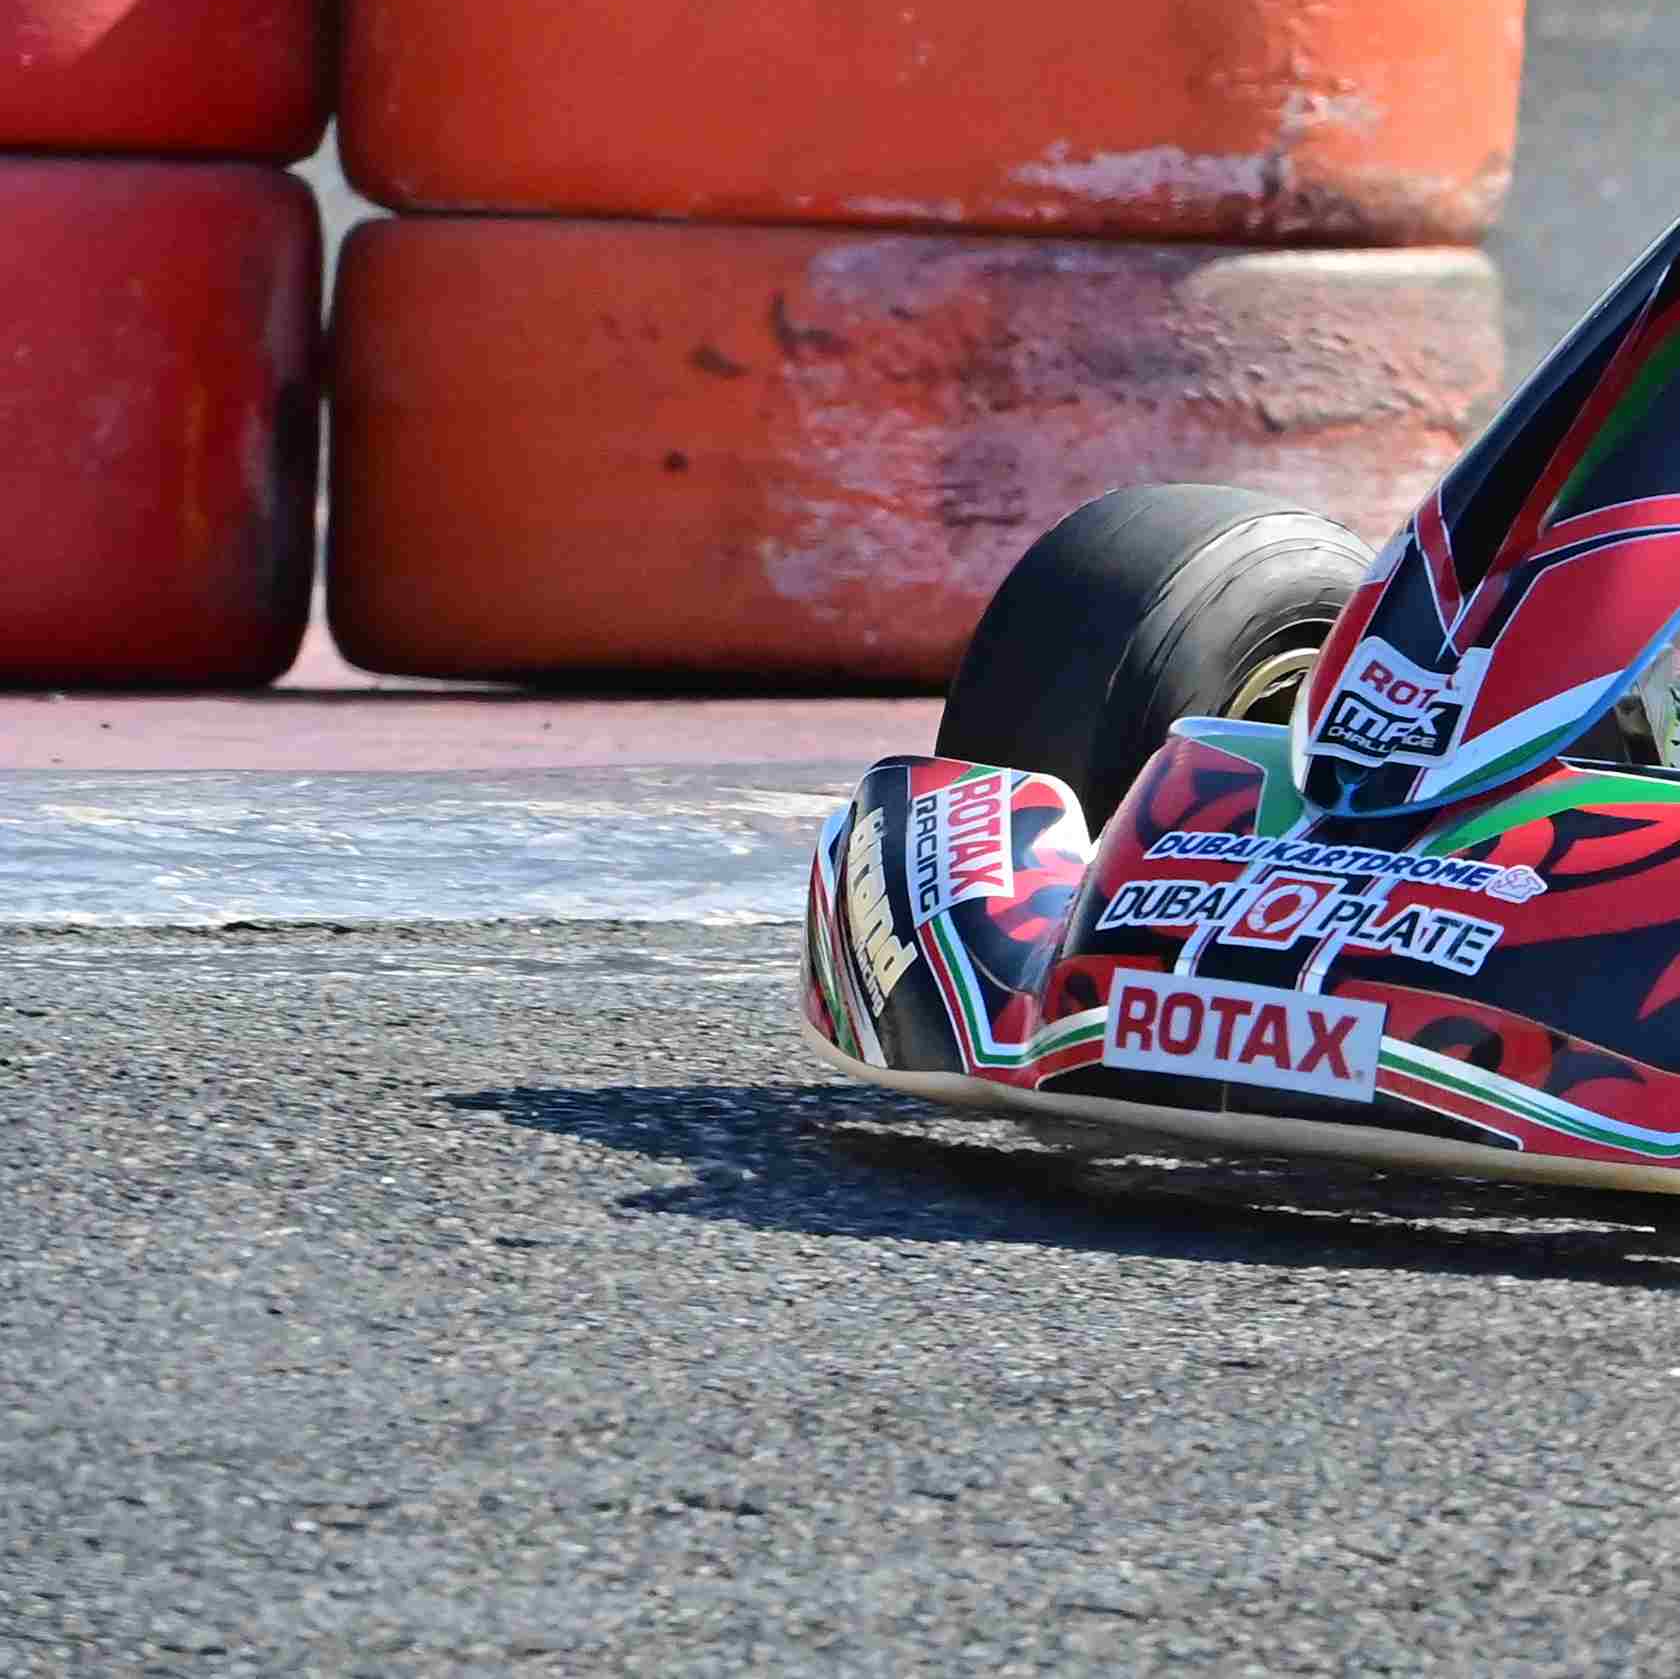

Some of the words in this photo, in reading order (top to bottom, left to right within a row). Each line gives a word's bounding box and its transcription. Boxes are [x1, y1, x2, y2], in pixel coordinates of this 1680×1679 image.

[914, 795, 940, 914] RACING
[947, 775, 1004, 897] ROTAX
[1152, 834, 1262, 858] DUBAI
[1266, 841, 1494, 887] KARTDROME
[1107, 885, 1238, 921] DUBAI
[1318, 899, 1496, 967] PLATE
[1115, 986, 1359, 1081] ROTAX
